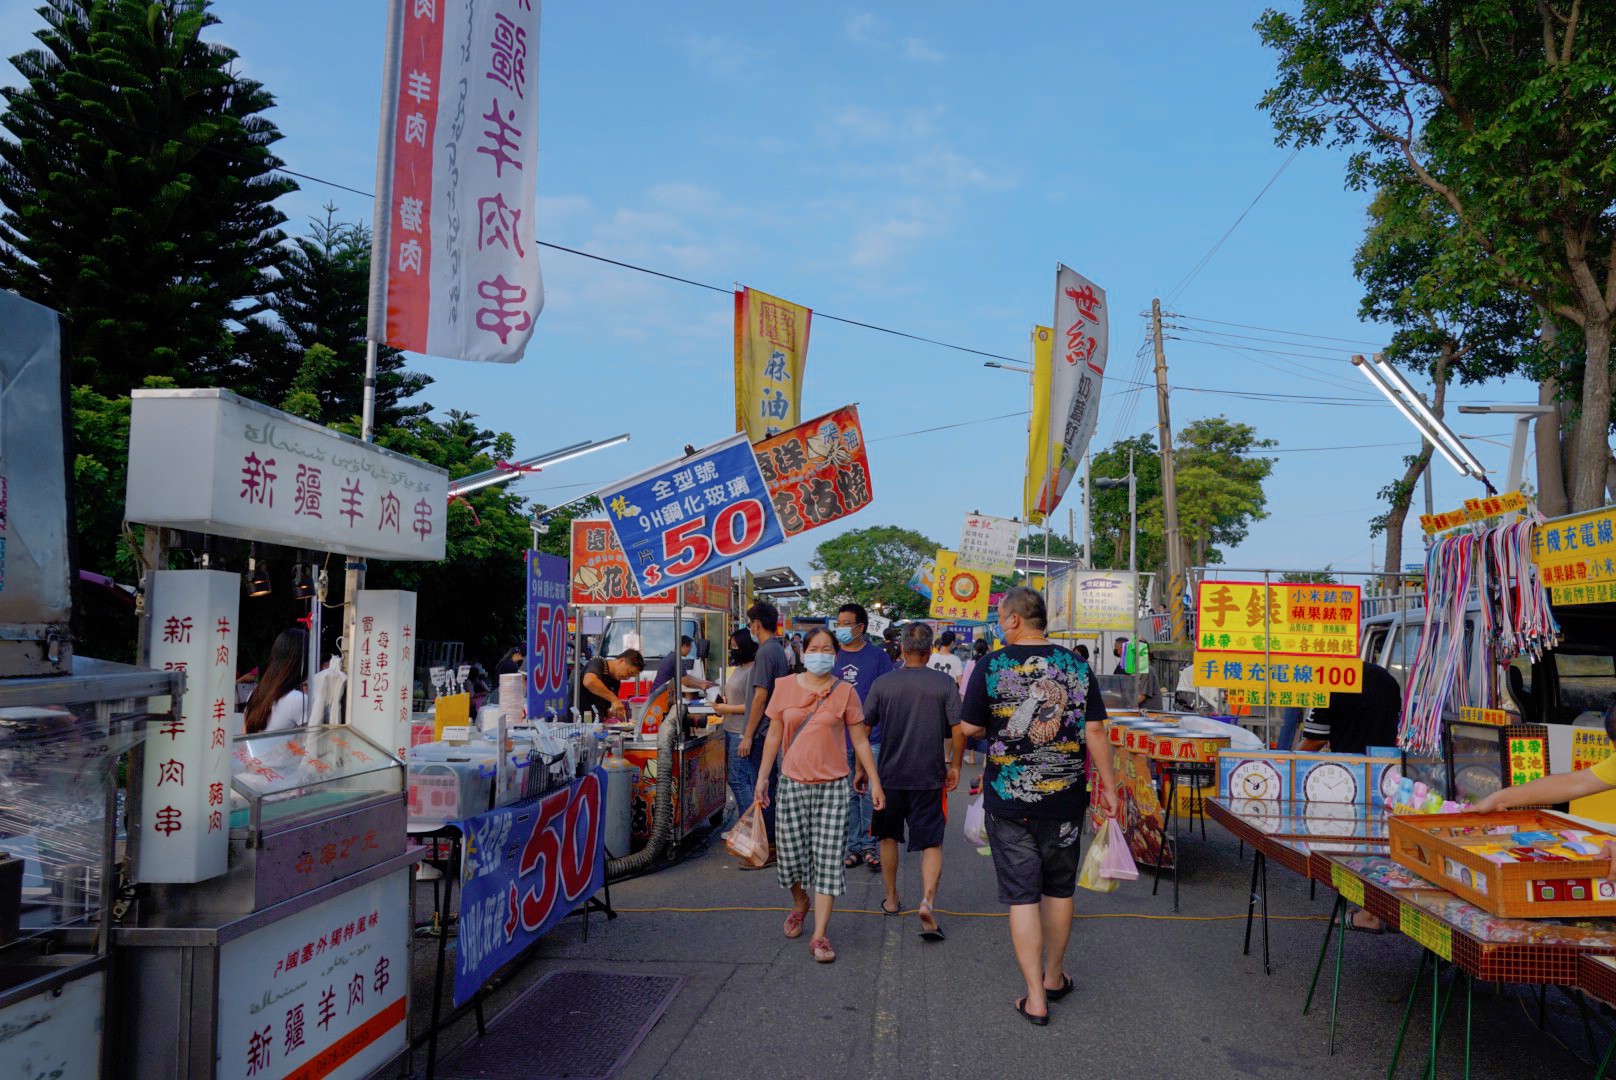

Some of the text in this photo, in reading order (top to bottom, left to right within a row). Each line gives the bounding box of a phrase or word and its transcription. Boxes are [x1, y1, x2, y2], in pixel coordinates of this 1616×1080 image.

[240, 451, 433, 542] 新疆羊肉串
[651, 461, 719, 501] 全型號
[639, 475, 751, 533] 9H鋼化玻璃
[967, 518, 993, 531] 世紀
[1532, 518, 1614, 556] 手機充電線
[1543, 561, 1587, 584] 蘋果錶帶
[1203, 585, 1284, 628] 手錶
[1291, 588, 1354, 604] 小米錶帶
[1291, 605, 1353, 621] 蘋果錶帶
[360, 616, 374, 699] 買4送1
[534, 603, 567, 694] 50
[1202, 633, 1355, 653] 錶帶 電池 各種維修
[373, 631, 389, 712] 每串25元
[1246, 689, 1327, 707] 遙控器電池
[1511, 739, 1542, 755] 錶帶
[1511, 755, 1543, 771] 電池
[246, 955, 391, 1076] 新疆羊肉串
